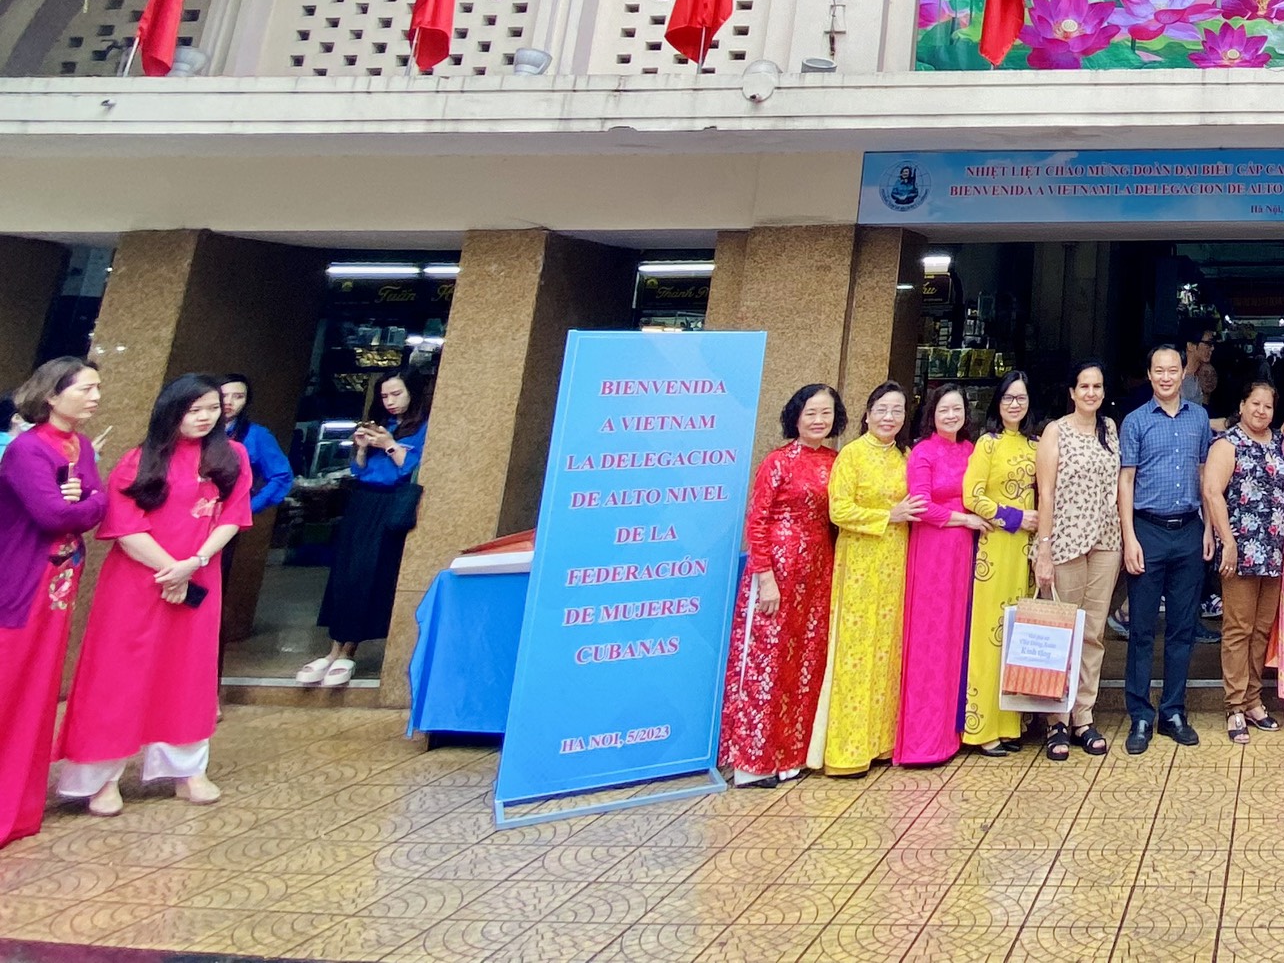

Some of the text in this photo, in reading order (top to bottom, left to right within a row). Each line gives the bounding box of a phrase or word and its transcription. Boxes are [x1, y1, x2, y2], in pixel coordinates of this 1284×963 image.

[966, 164, 1009, 179] NHIỆT
[1011, 164, 1041, 179] LIỆT
[950, 185, 1033, 196] BIENVENIDA
[1036, 185, 1044, 196] A
[1048, 184, 1110, 196] VIETNAM
[1114, 184, 1132, 195] LA
[1135, 183, 1224, 195] DELEGACION
[1228, 183, 1245, 194] DE
[1249, 183, 1283, 194] ALTO
[601, 380, 727, 395] BIENVENIDA
[601, 415, 716, 432] A VIETNAM
[567, 449, 737, 470] LA DELEGACION
[571, 486, 728, 507] DE ALTO NIVEL
[616, 525, 678, 543] DE LA
[567, 556, 707, 585] FEDERACIÓN
[565, 597, 699, 625] DE MUJERES
[576, 637, 679, 663] CUBANAS
[562, 726, 670, 752] HA NOI, 5/2023
